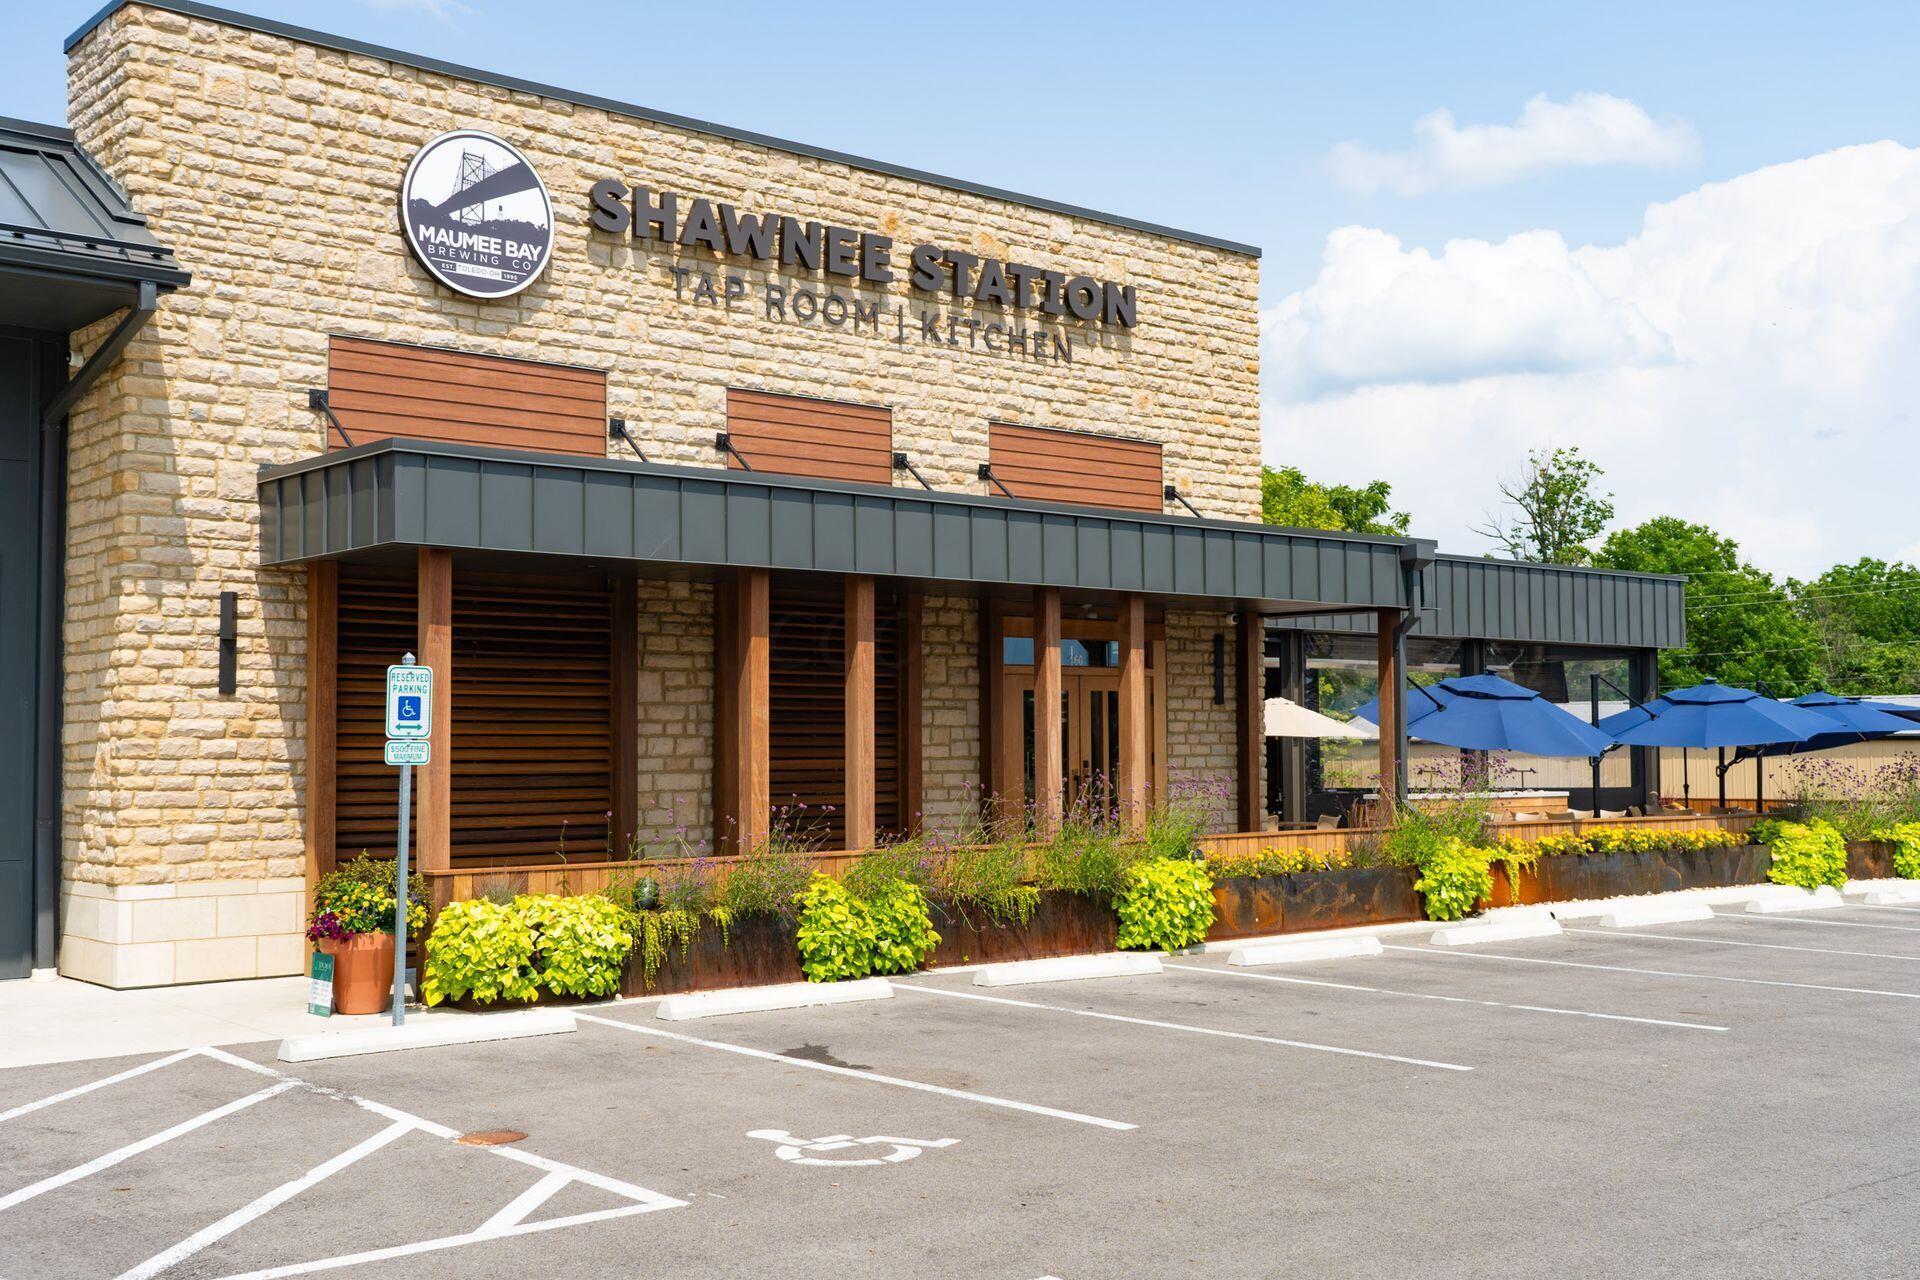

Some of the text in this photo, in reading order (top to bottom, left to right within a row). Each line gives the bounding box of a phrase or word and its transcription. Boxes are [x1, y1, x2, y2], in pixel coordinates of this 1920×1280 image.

[419, 224, 543, 261] MAUMEE BAY
[428, 244, 531, 270] BREWING CO
[589, 179, 1137, 329] SHAWNEE STATION
[669, 266, 745, 309] TAP
[765, 283, 879, 332] ROOM
[921, 310, 1073, 363] KITCHEN
[392, 673, 429, 682] RESERVED
[393, 685, 427, 694] PARKING
[391, 745, 409, 753] $500
[393, 753, 422, 761] MAXIMUM
